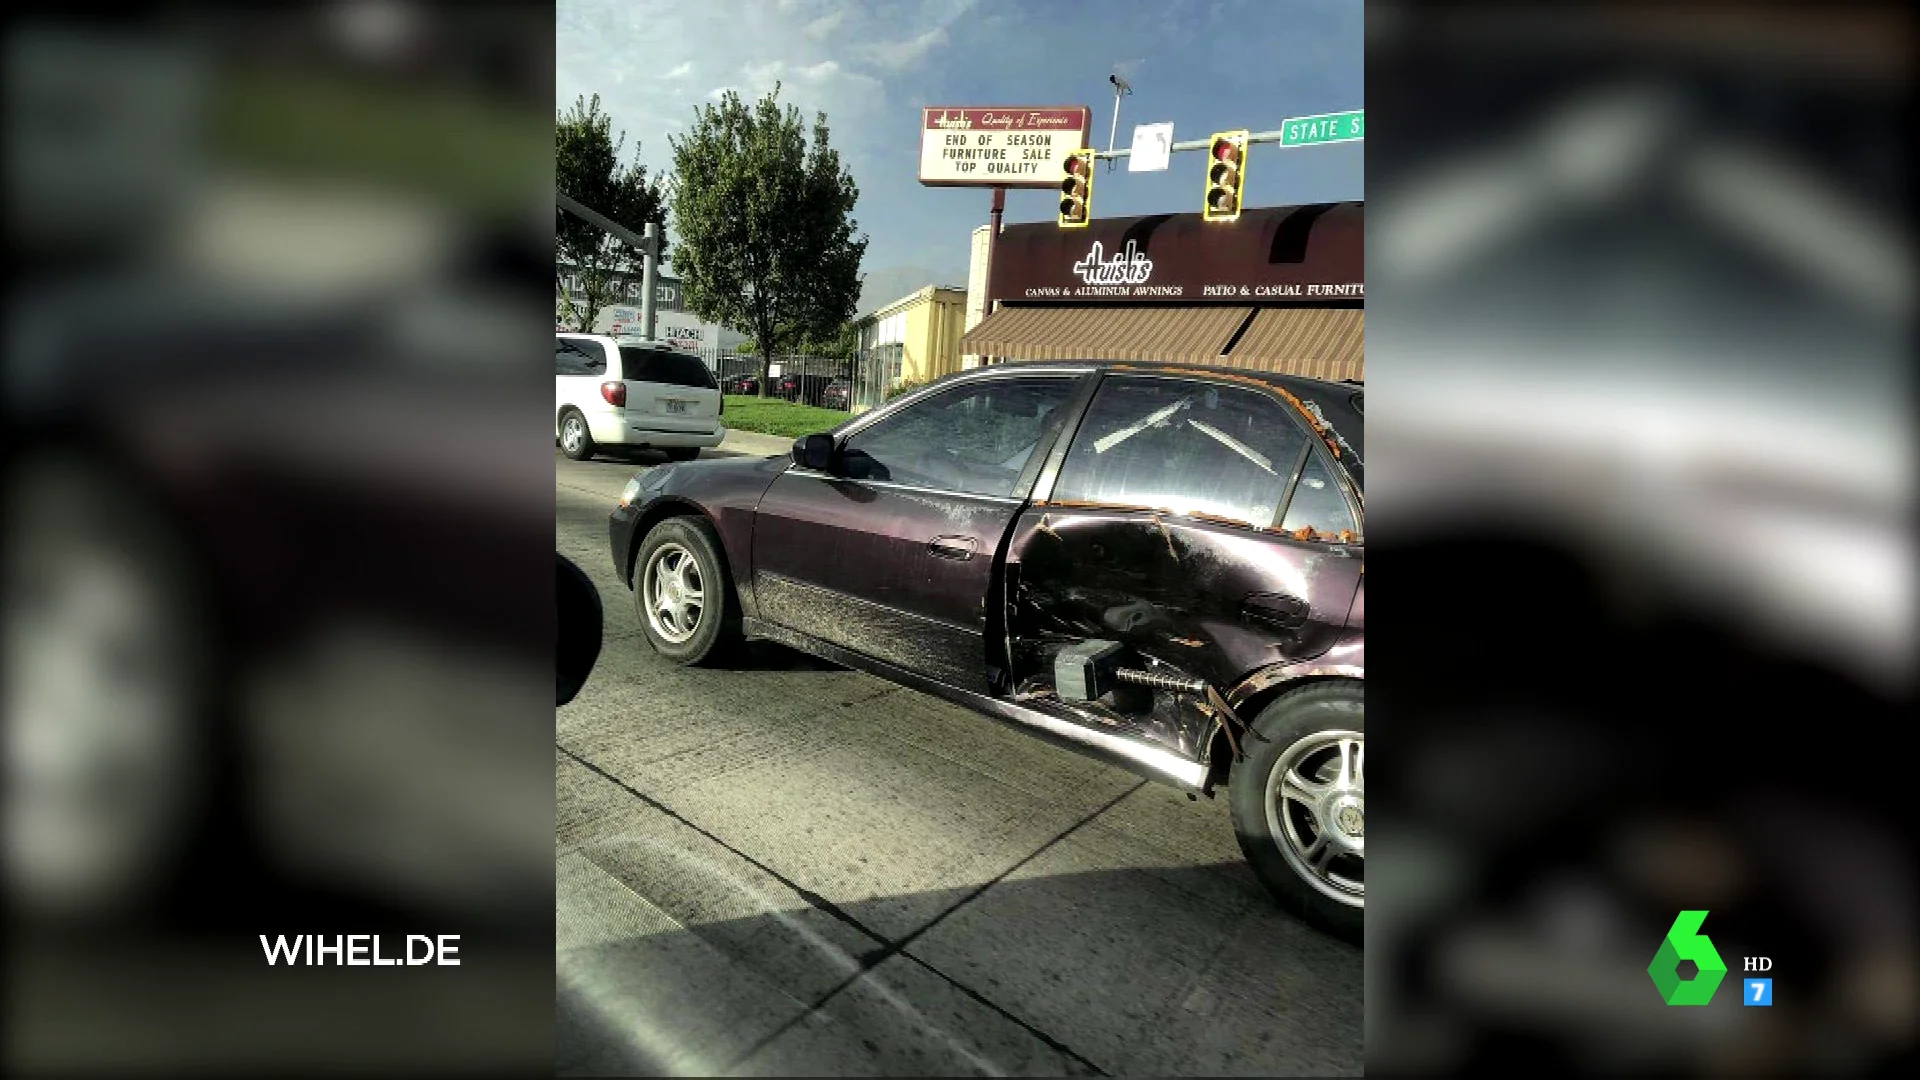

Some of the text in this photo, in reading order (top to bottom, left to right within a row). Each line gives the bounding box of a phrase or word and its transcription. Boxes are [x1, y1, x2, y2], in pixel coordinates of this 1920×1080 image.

[981, 112, 1014, 129] Quality
[1016, 113, 1026, 128] of
[1289, 117, 1364, 140] STATE S
[945, 134, 1052, 146] END OF SEASON
[942, 148, 1051, 160] FURNITURE SALE
[955, 161, 1038, 174] TOP QUALITY
[1025, 286, 1183, 297] CANVAS & ALUMINUM AWNINGS
[1203, 284, 1237, 296] PATIO
[1239, 284, 1250, 296] &
[1255, 284, 1302, 296] CASUAL
